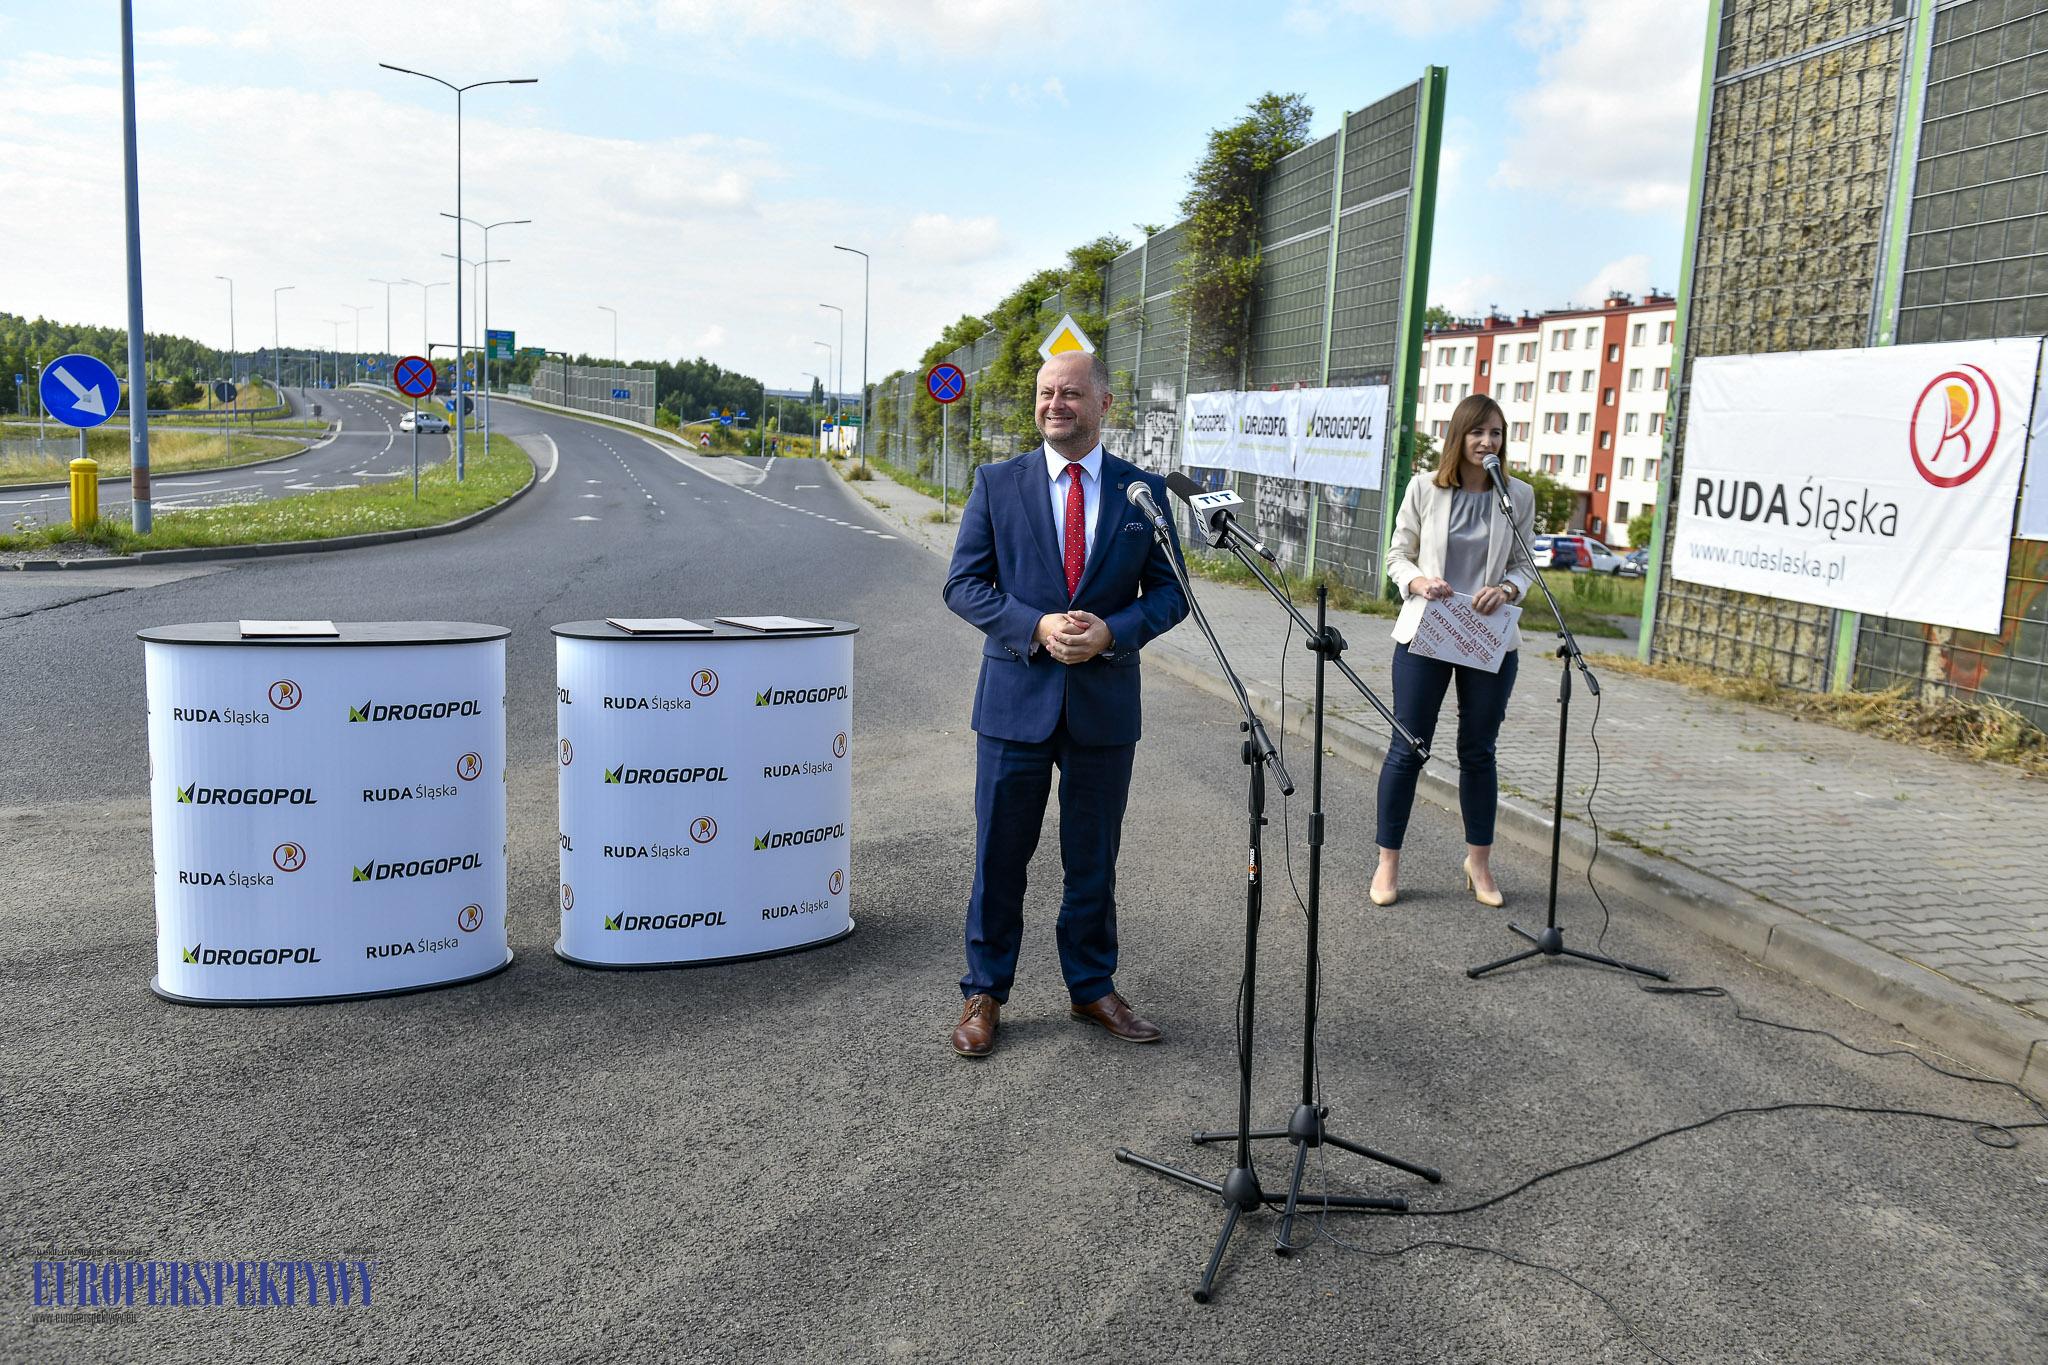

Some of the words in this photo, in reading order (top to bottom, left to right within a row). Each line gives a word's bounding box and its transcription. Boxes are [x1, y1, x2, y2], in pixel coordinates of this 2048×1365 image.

[1315, 415, 1373, 440] DROGOPOL
[1693, 477, 1790, 526] RUDA
[1796, 476, 1898, 541] Śląska
[1688, 541, 1846, 586] www.rudaslaska.pl
[1440, 597, 1479, 636] DZIEDZICTW
[1418, 617, 1445, 645] INWES
[603, 696, 650, 710] RUDA
[651, 696, 691, 712] Śląska
[773, 684, 849, 706] DROGOPOL
[173, 707, 221, 723] RUDA
[223, 707, 269, 726] Śląska
[372, 699, 482, 722] DROGOPOL
[624, 766, 729, 785] DROGOPOL
[763, 764, 801, 779] RUDA
[802, 760, 833, 776] Śląska
[196, 787, 318, 805] DROGOPOL
[363, 786, 413, 803] RUDA
[415, 783, 458, 800] Śląska
[770, 823, 845, 848] DROGOPOL
[604, 845, 649, 858] RUDA
[650, 844, 690, 860] Śląska
[375, 852, 483, 881] DROGOPOL
[179, 870, 226, 886] RUDA
[228, 870, 274, 889] Śląska
[761, 904, 799, 921] RUDA
[799, 898, 829, 914] Śląska
[624, 911, 727, 931] DROGOPOL
[202, 947, 322, 966] DROGOPOL
[366, 942, 415, 960] RUDA
[417, 936, 459, 954] Śląska
